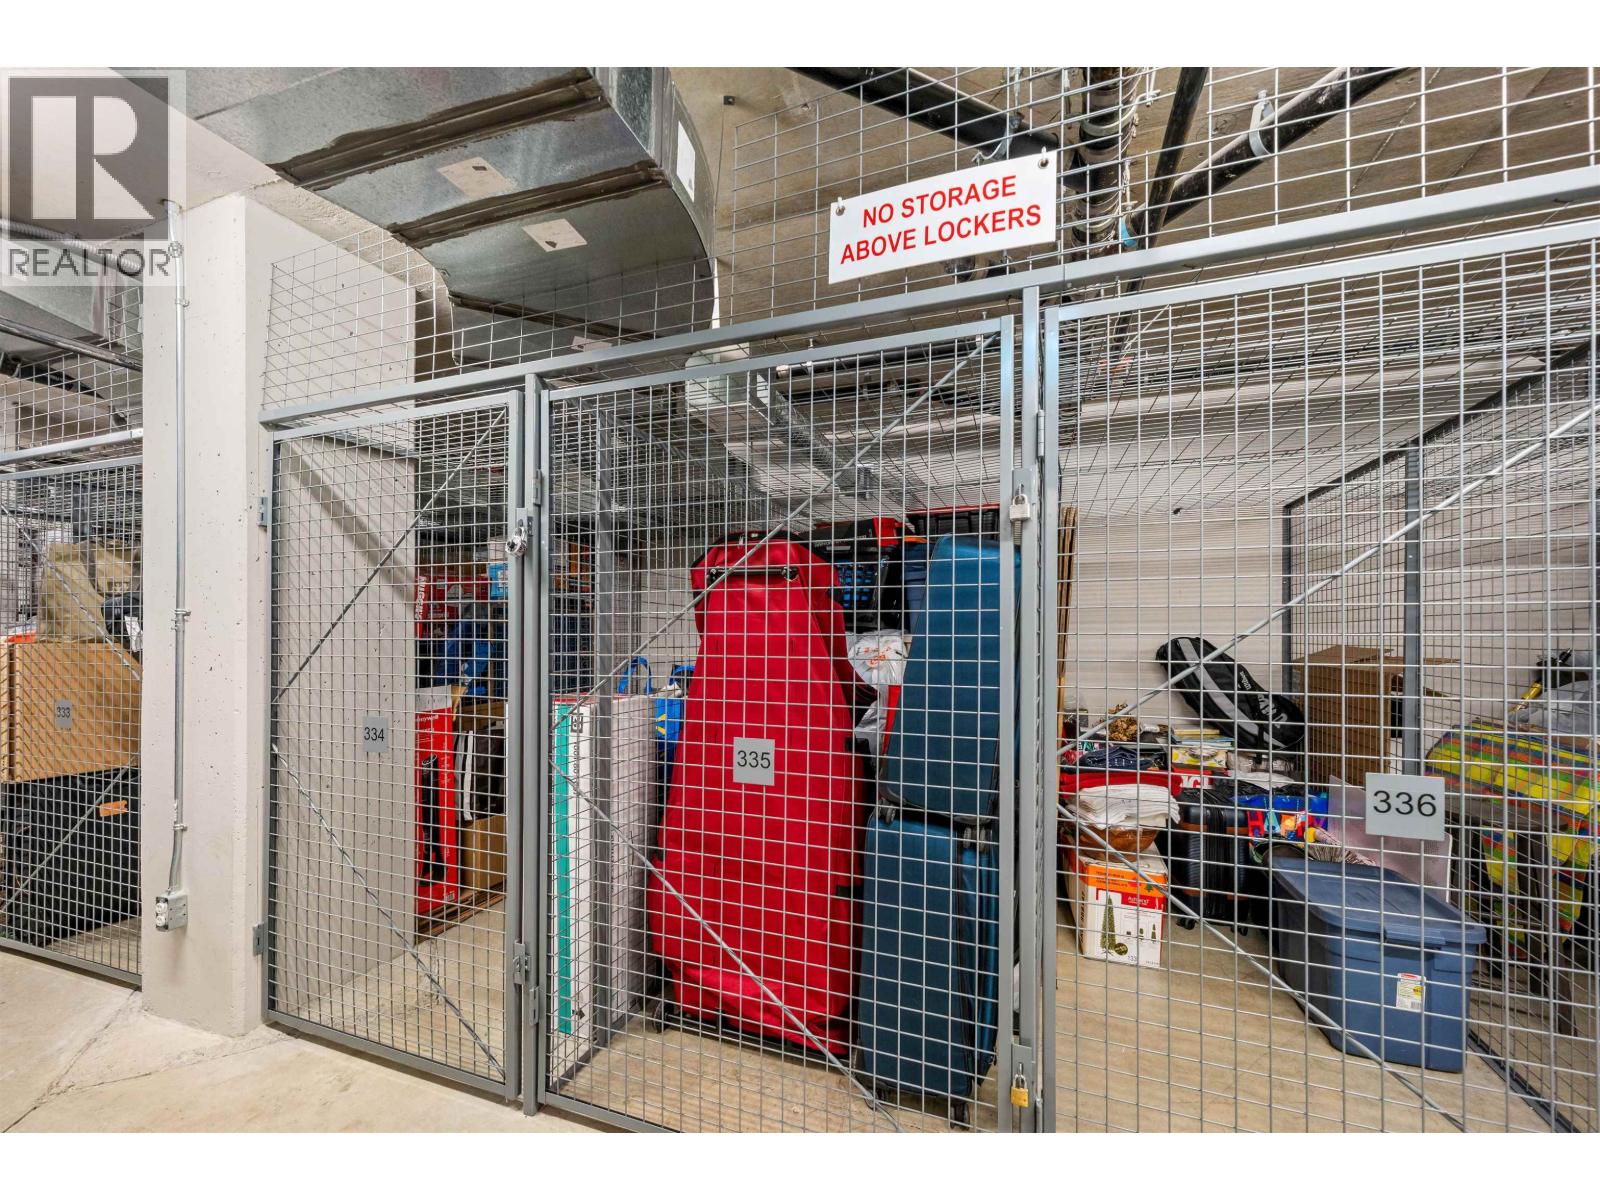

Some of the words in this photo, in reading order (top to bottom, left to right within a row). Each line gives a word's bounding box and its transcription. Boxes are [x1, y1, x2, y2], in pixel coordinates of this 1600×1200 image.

[862, 203, 894, 228] NO
[901, 175, 1017, 219] STORAGE
[840, 228, 917, 265] ABOVE
[924, 204, 1042, 246] LOCKERS
[57, 706, 71, 718] 333
[363, 726, 385, 742] 334
[736, 750, 771, 769] 335
[1373, 790, 1437, 817] 336
